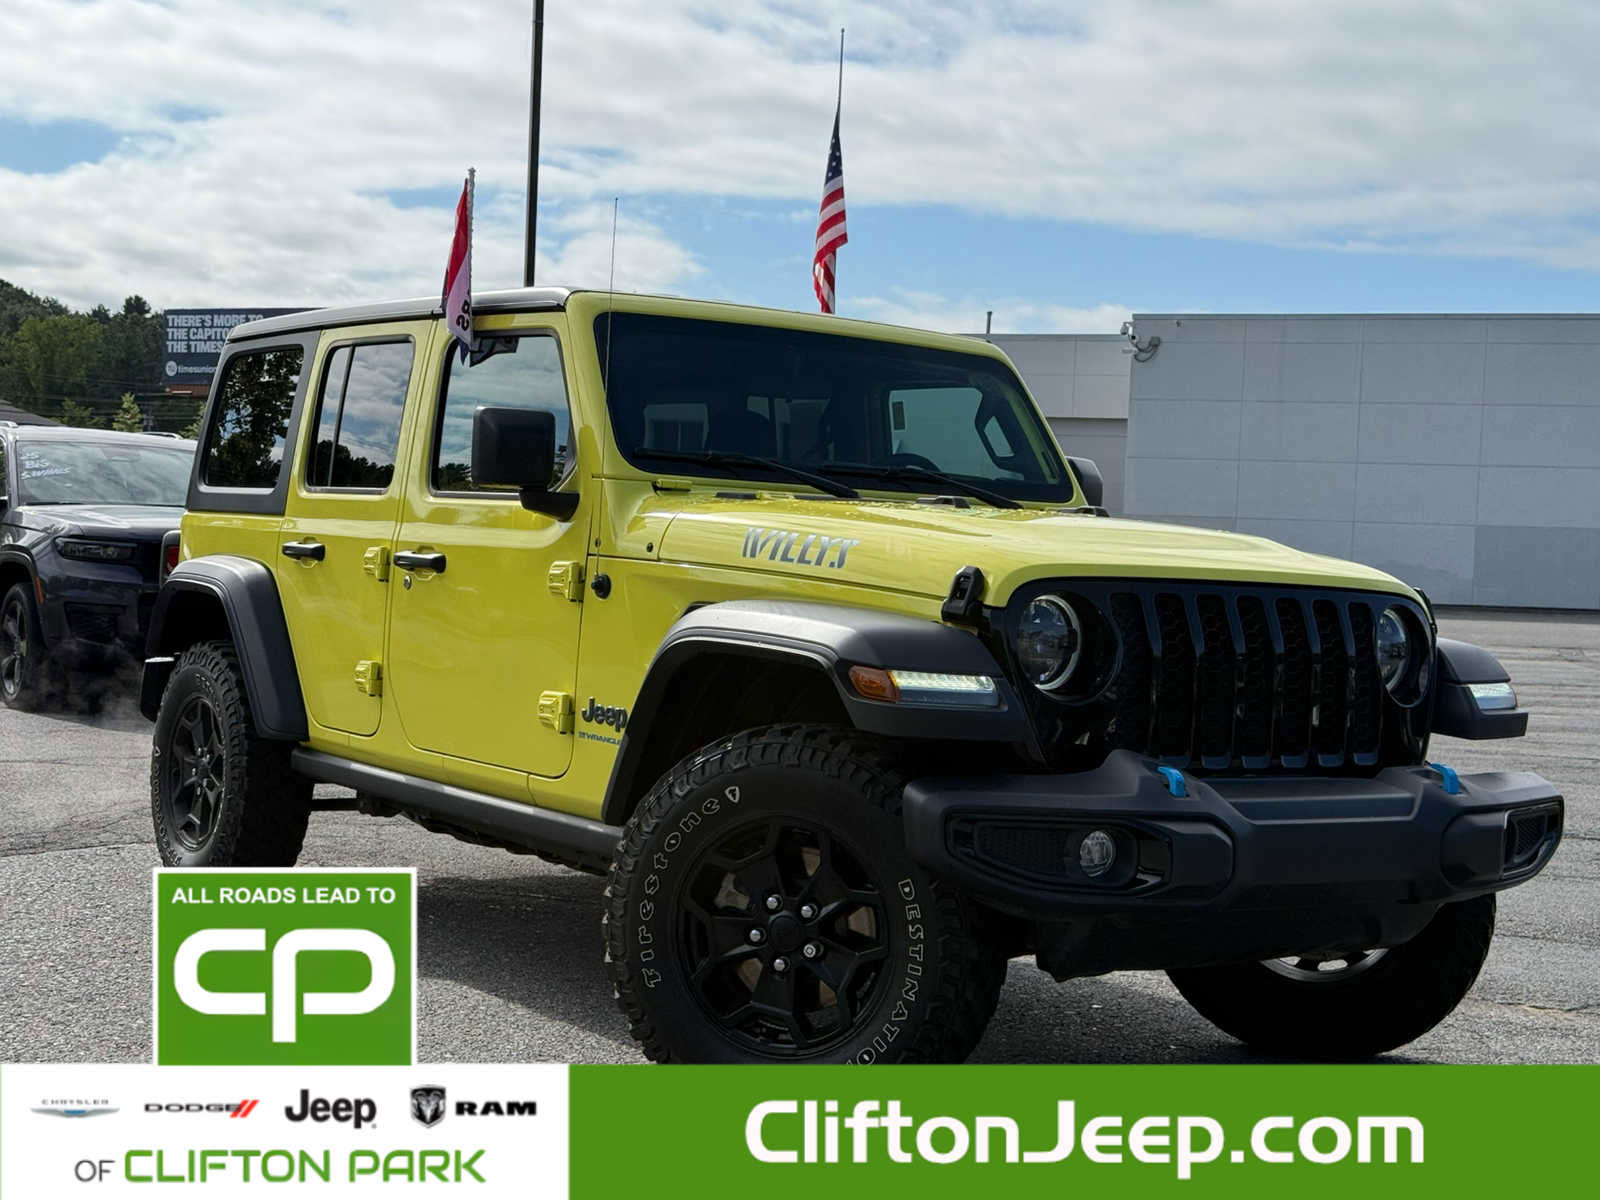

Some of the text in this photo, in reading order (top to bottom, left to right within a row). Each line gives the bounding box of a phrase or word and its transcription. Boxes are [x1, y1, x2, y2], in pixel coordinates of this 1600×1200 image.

[166, 315, 212, 327] THERE'S
[213, 314, 247, 327] MORE
[166, 328, 229, 340] THE CAPITO
[166, 341, 188, 353] THE
[742, 527, 861, 569] WILLYS
[581, 696, 628, 733] Jeep
[846, 878, 924, 1065] DESTINATIO
